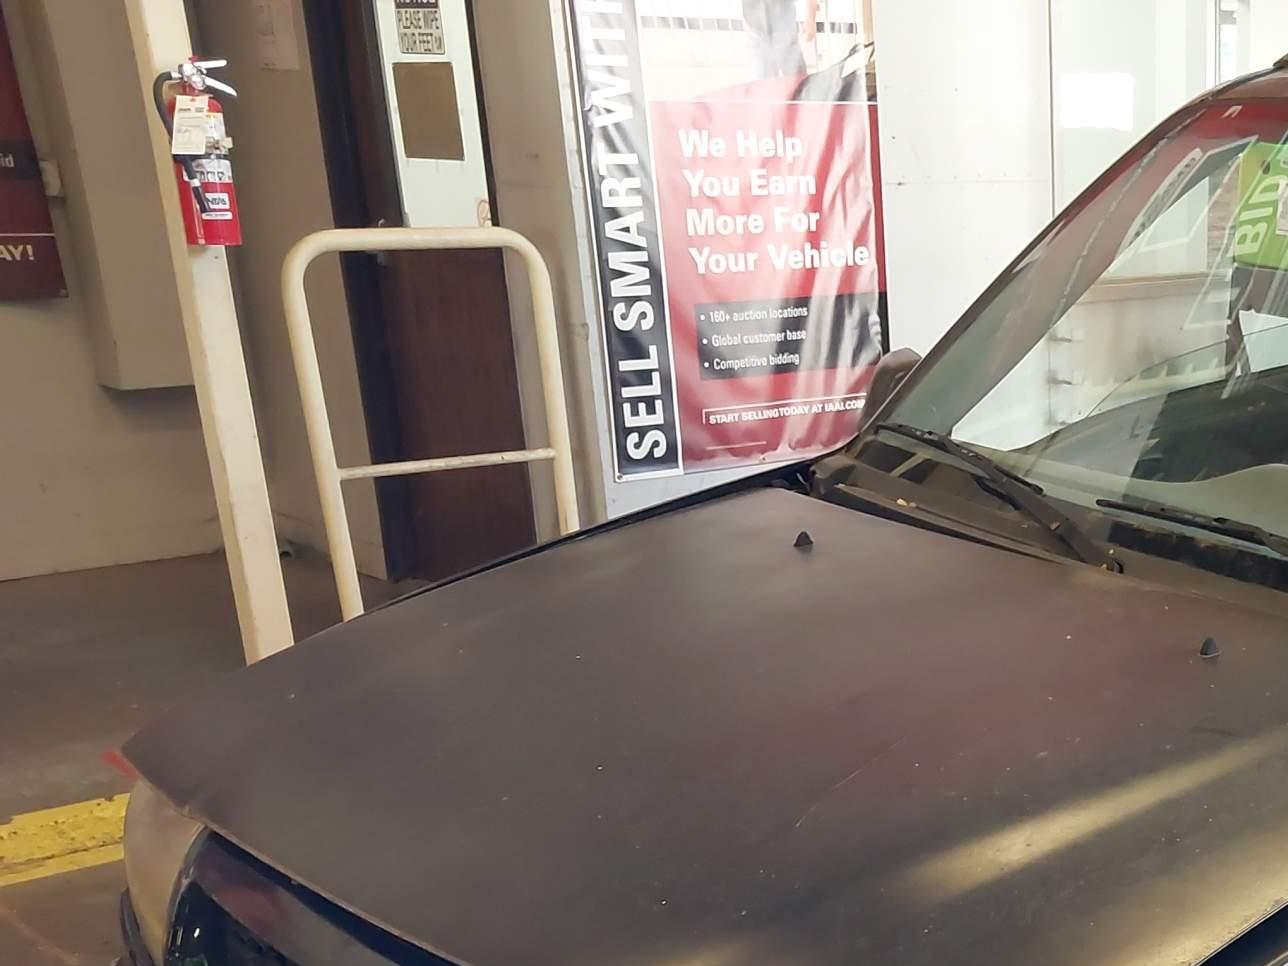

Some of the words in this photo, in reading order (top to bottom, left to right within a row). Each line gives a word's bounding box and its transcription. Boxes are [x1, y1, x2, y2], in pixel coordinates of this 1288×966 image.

[397, 10, 422, 30] PLEASE
[423, 10, 440, 30] WIPE
[400, 32, 417, 51] YOUR
[418, 32, 433, 51] FEET
[679, 129, 726, 158] We
[735, 129, 802, 164] Help
[682, 169, 740, 197] You
[751, 168, 816, 196] Earn
[686, 208, 764, 236] More
[774, 206, 821, 233] For
[598, 142, 655, 331] SMART
[688, 247, 758, 275] Your
[767, 240, 870, 270] Vehicle
[733, 310, 768, 322] auction
[769, 306, 808, 320] locations
[712, 333, 741, 347] Global
[743, 331, 785, 345] customer
[786, 329, 807, 341] base
[713, 357, 768, 372] Competitive
[768, 351, 800, 366] bidding
[618, 344, 667, 460] SELL
[709, 413, 740, 425] START
[741, 408, 779, 421] SELLING
[779, 405, 810, 417] TODAY
[811, 403, 823, 413] AT
